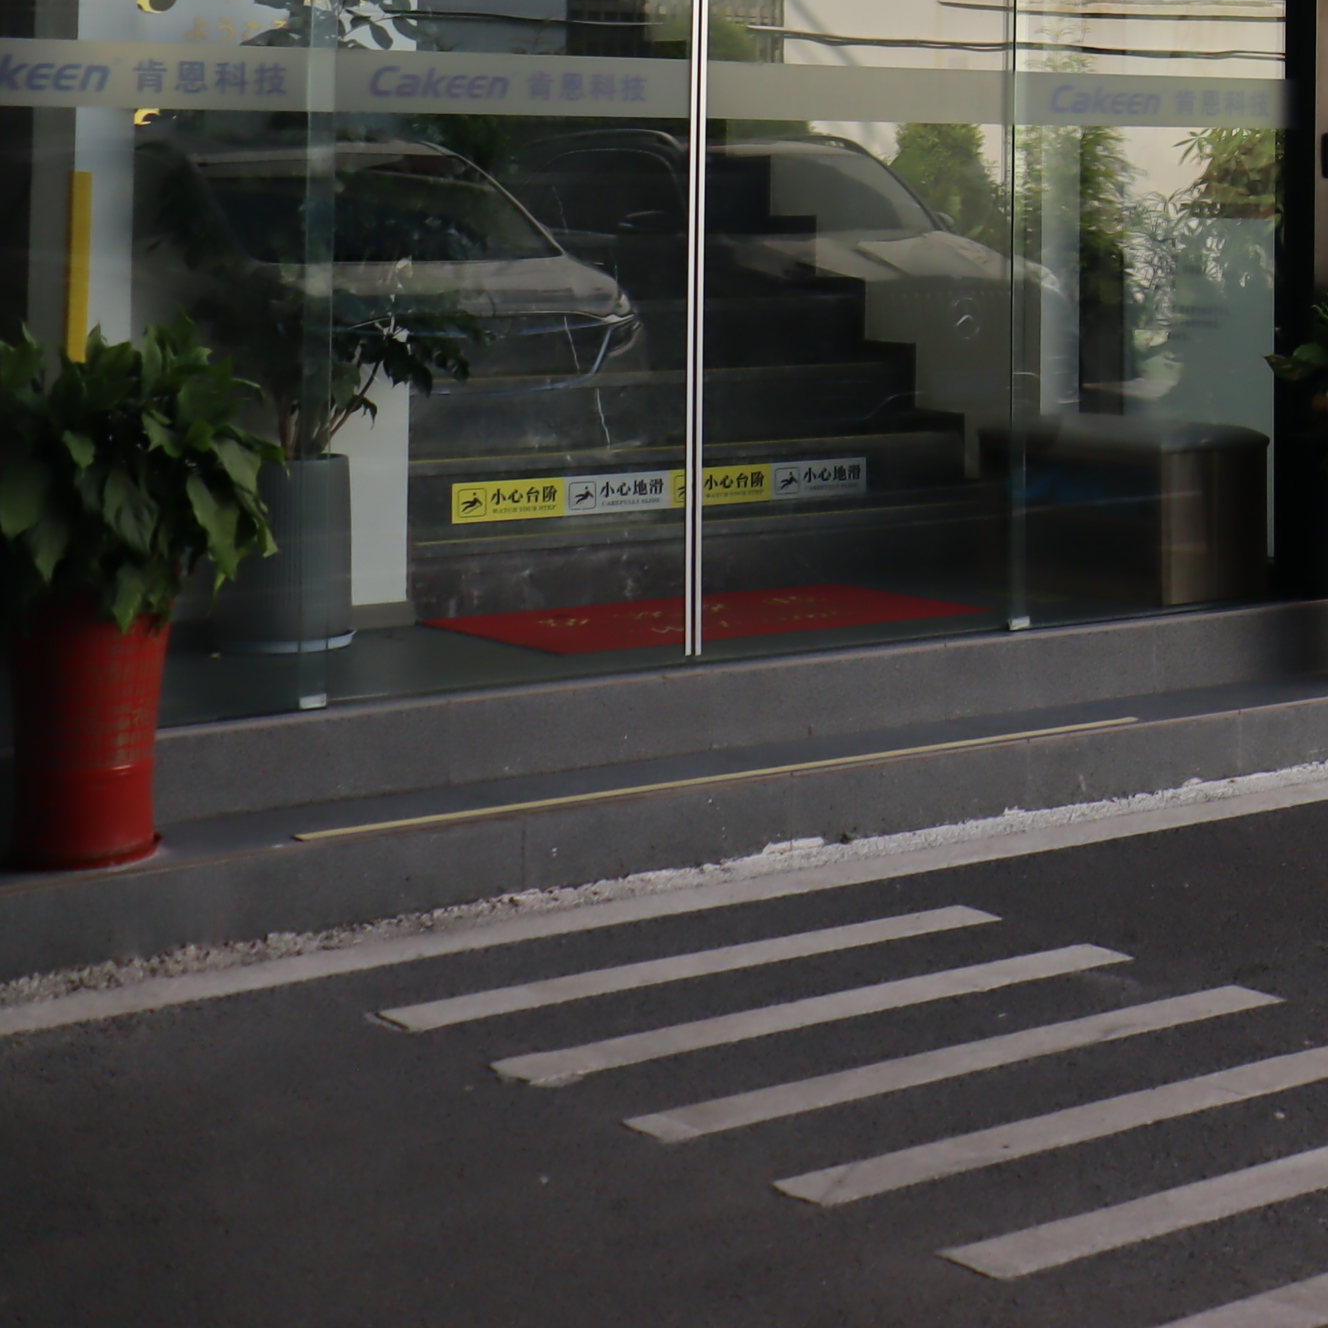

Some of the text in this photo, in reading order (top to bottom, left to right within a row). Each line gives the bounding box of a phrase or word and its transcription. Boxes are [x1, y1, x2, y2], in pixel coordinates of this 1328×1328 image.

[132, 58, 287, 97] 肯恩科技
[368, 65, 647, 103] Cakeen 肯恩科技
[1050, 83, 1272, 118] Cakeen 肯恩科技
[703, 470, 765, 491] 小心台阶
[803, 463, 861, 483] 小心地滑
[490, 484, 558, 506] 小心台阶
[600, 477, 664, 498] 小心地滑
